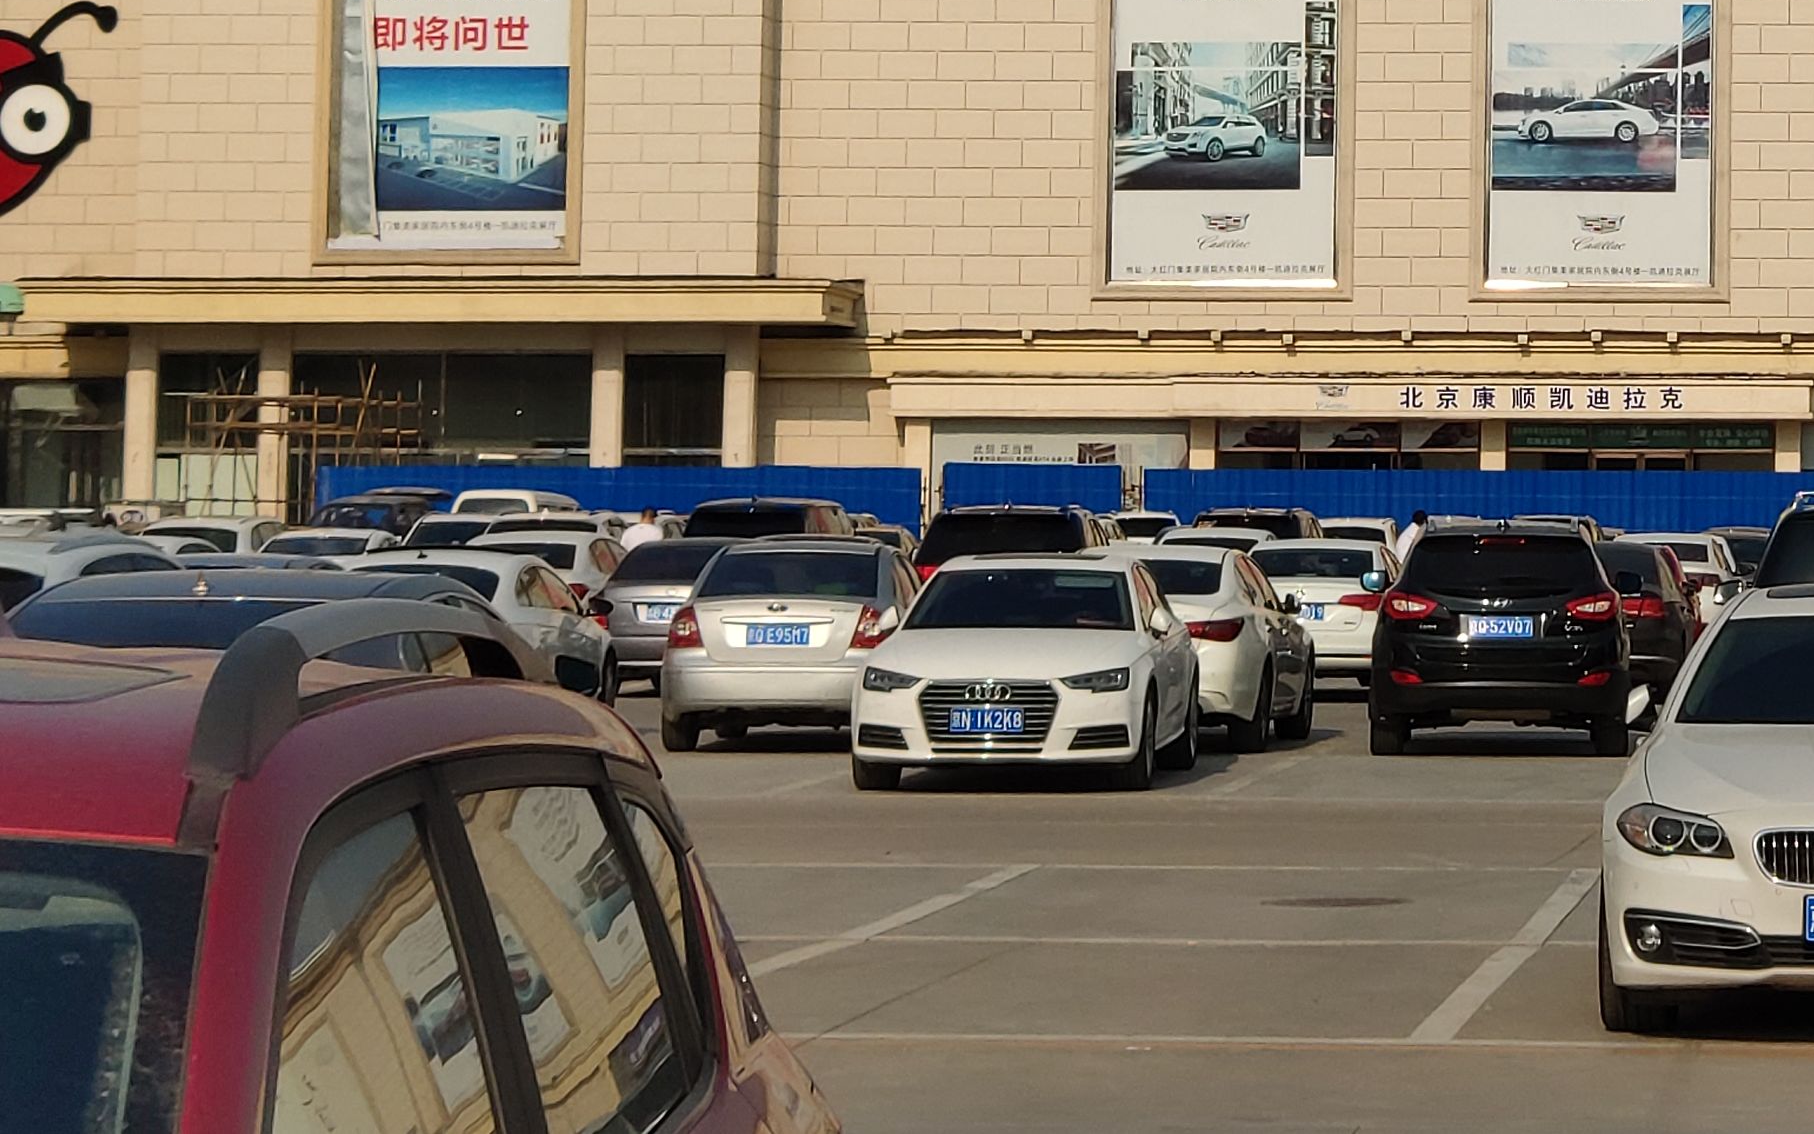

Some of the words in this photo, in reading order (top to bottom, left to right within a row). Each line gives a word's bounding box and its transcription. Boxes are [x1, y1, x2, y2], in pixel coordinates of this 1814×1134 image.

[375, 15, 530, 51] 即将问世
[1399, 386, 1683, 410] 北京康顺凯迪拉克
